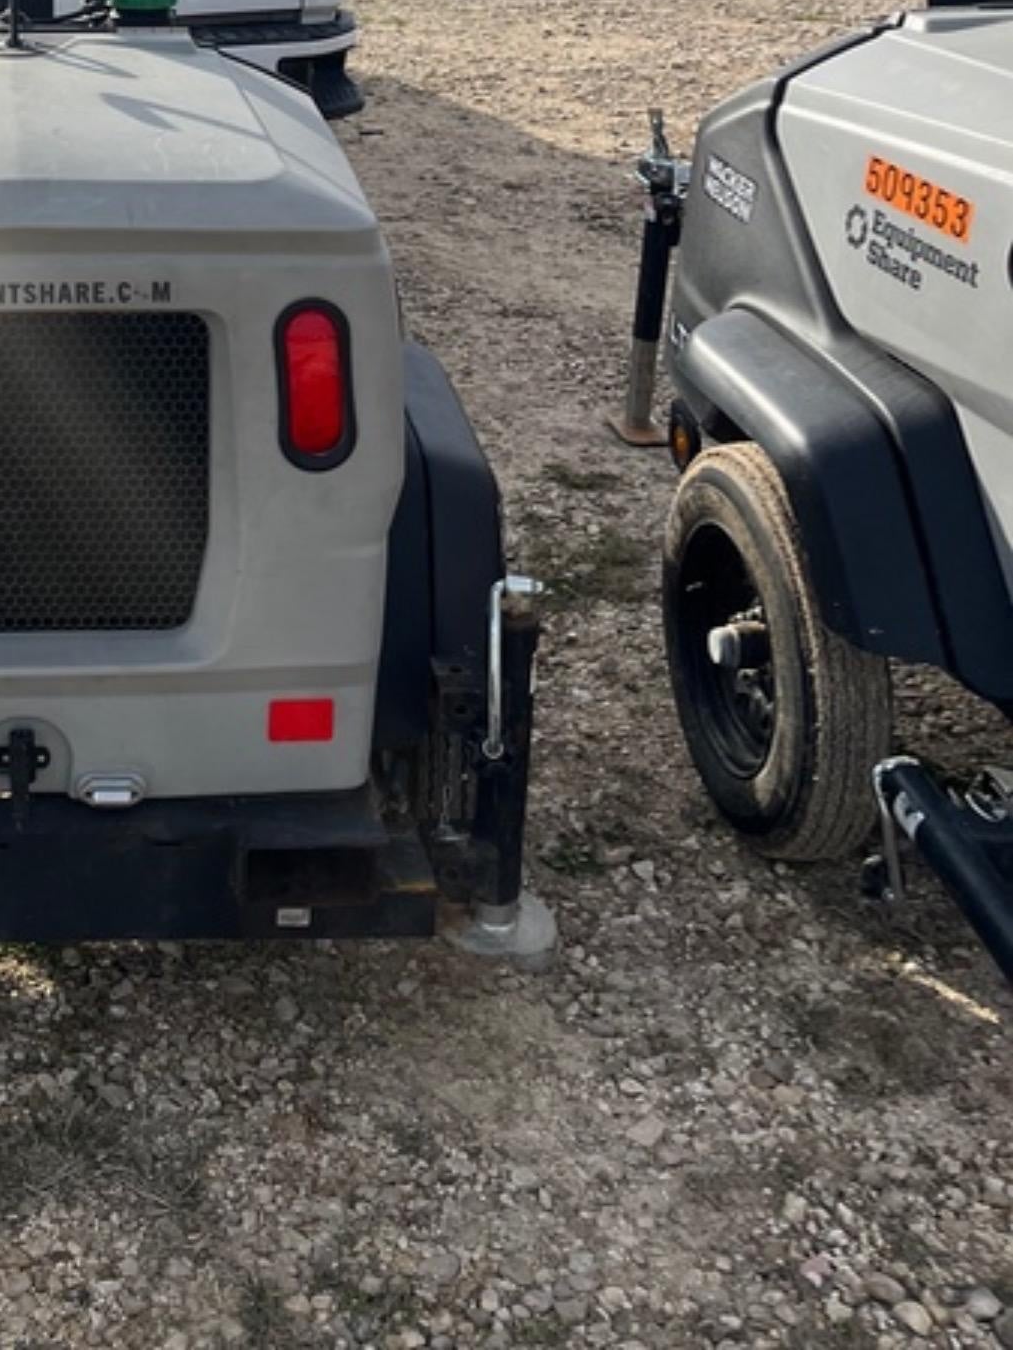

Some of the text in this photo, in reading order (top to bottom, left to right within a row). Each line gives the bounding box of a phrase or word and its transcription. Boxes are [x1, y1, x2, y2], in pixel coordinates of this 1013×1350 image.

[865, 156, 970, 238] 509353
[866, 239, 922, 290] Share
[871, 209, 980, 289] Equipment
